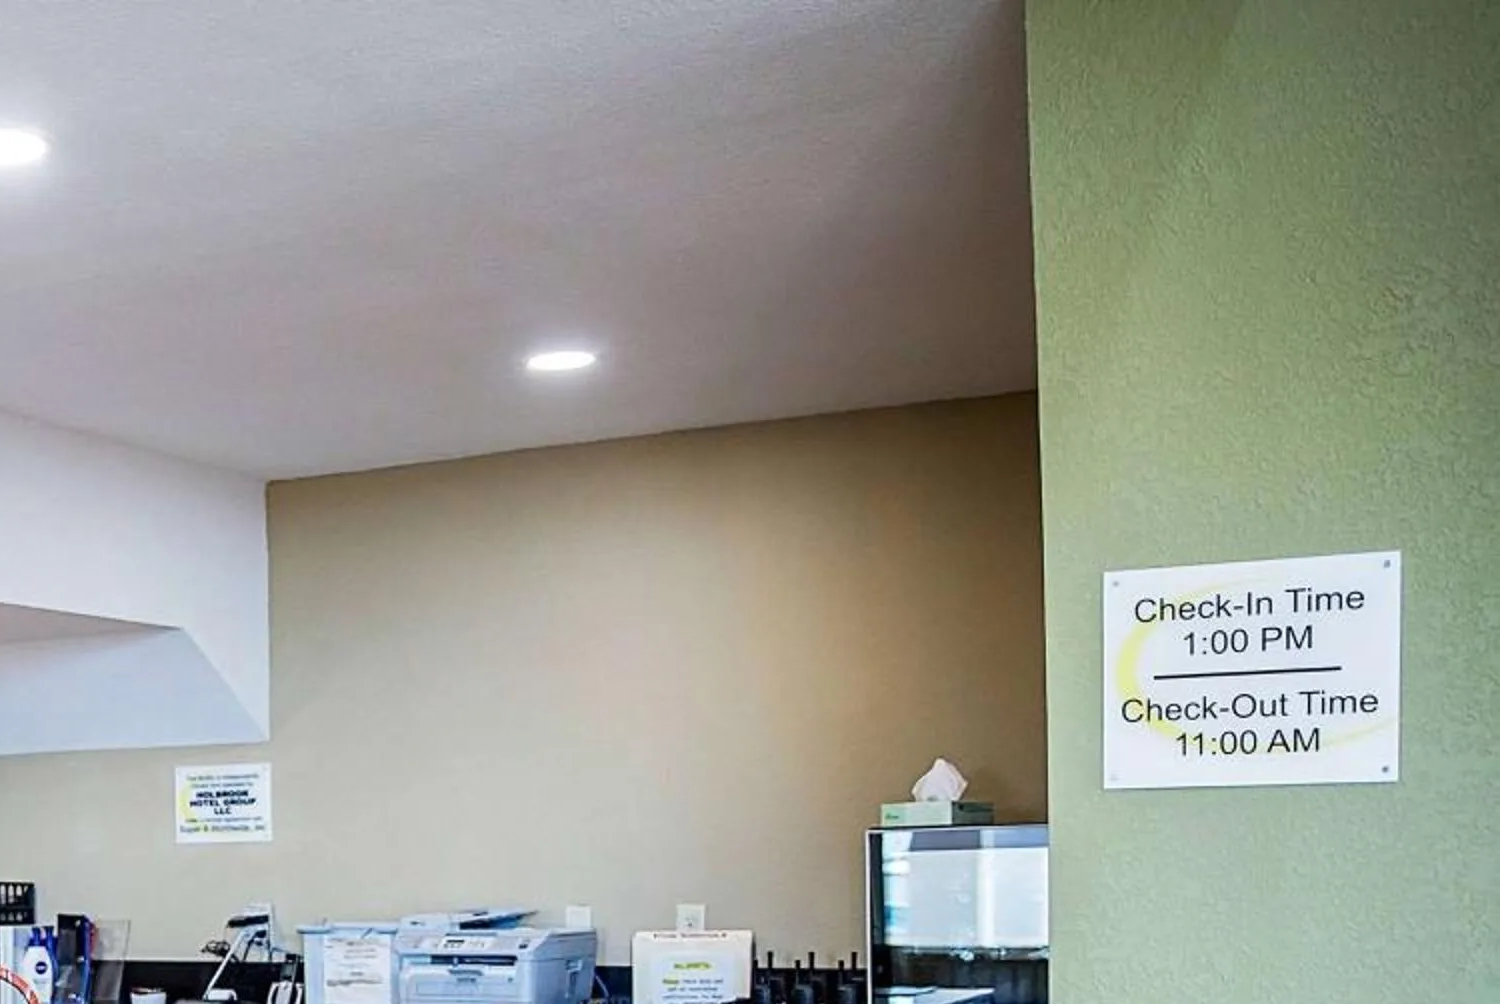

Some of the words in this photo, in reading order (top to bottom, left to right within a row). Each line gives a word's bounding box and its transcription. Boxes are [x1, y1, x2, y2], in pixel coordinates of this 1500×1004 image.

[1135, 591, 1273, 623] Check-In
[1285, 587, 1366, 614] Time
[1183, 629, 1249, 656] 1:00
[1261, 625, 1314, 651] PM
[1121, 693, 1289, 723] Check-Out
[1299, 690, 1379, 716] Time
[1176, 730, 1258, 756] 11:00
[1267, 727, 1321, 753] AM
